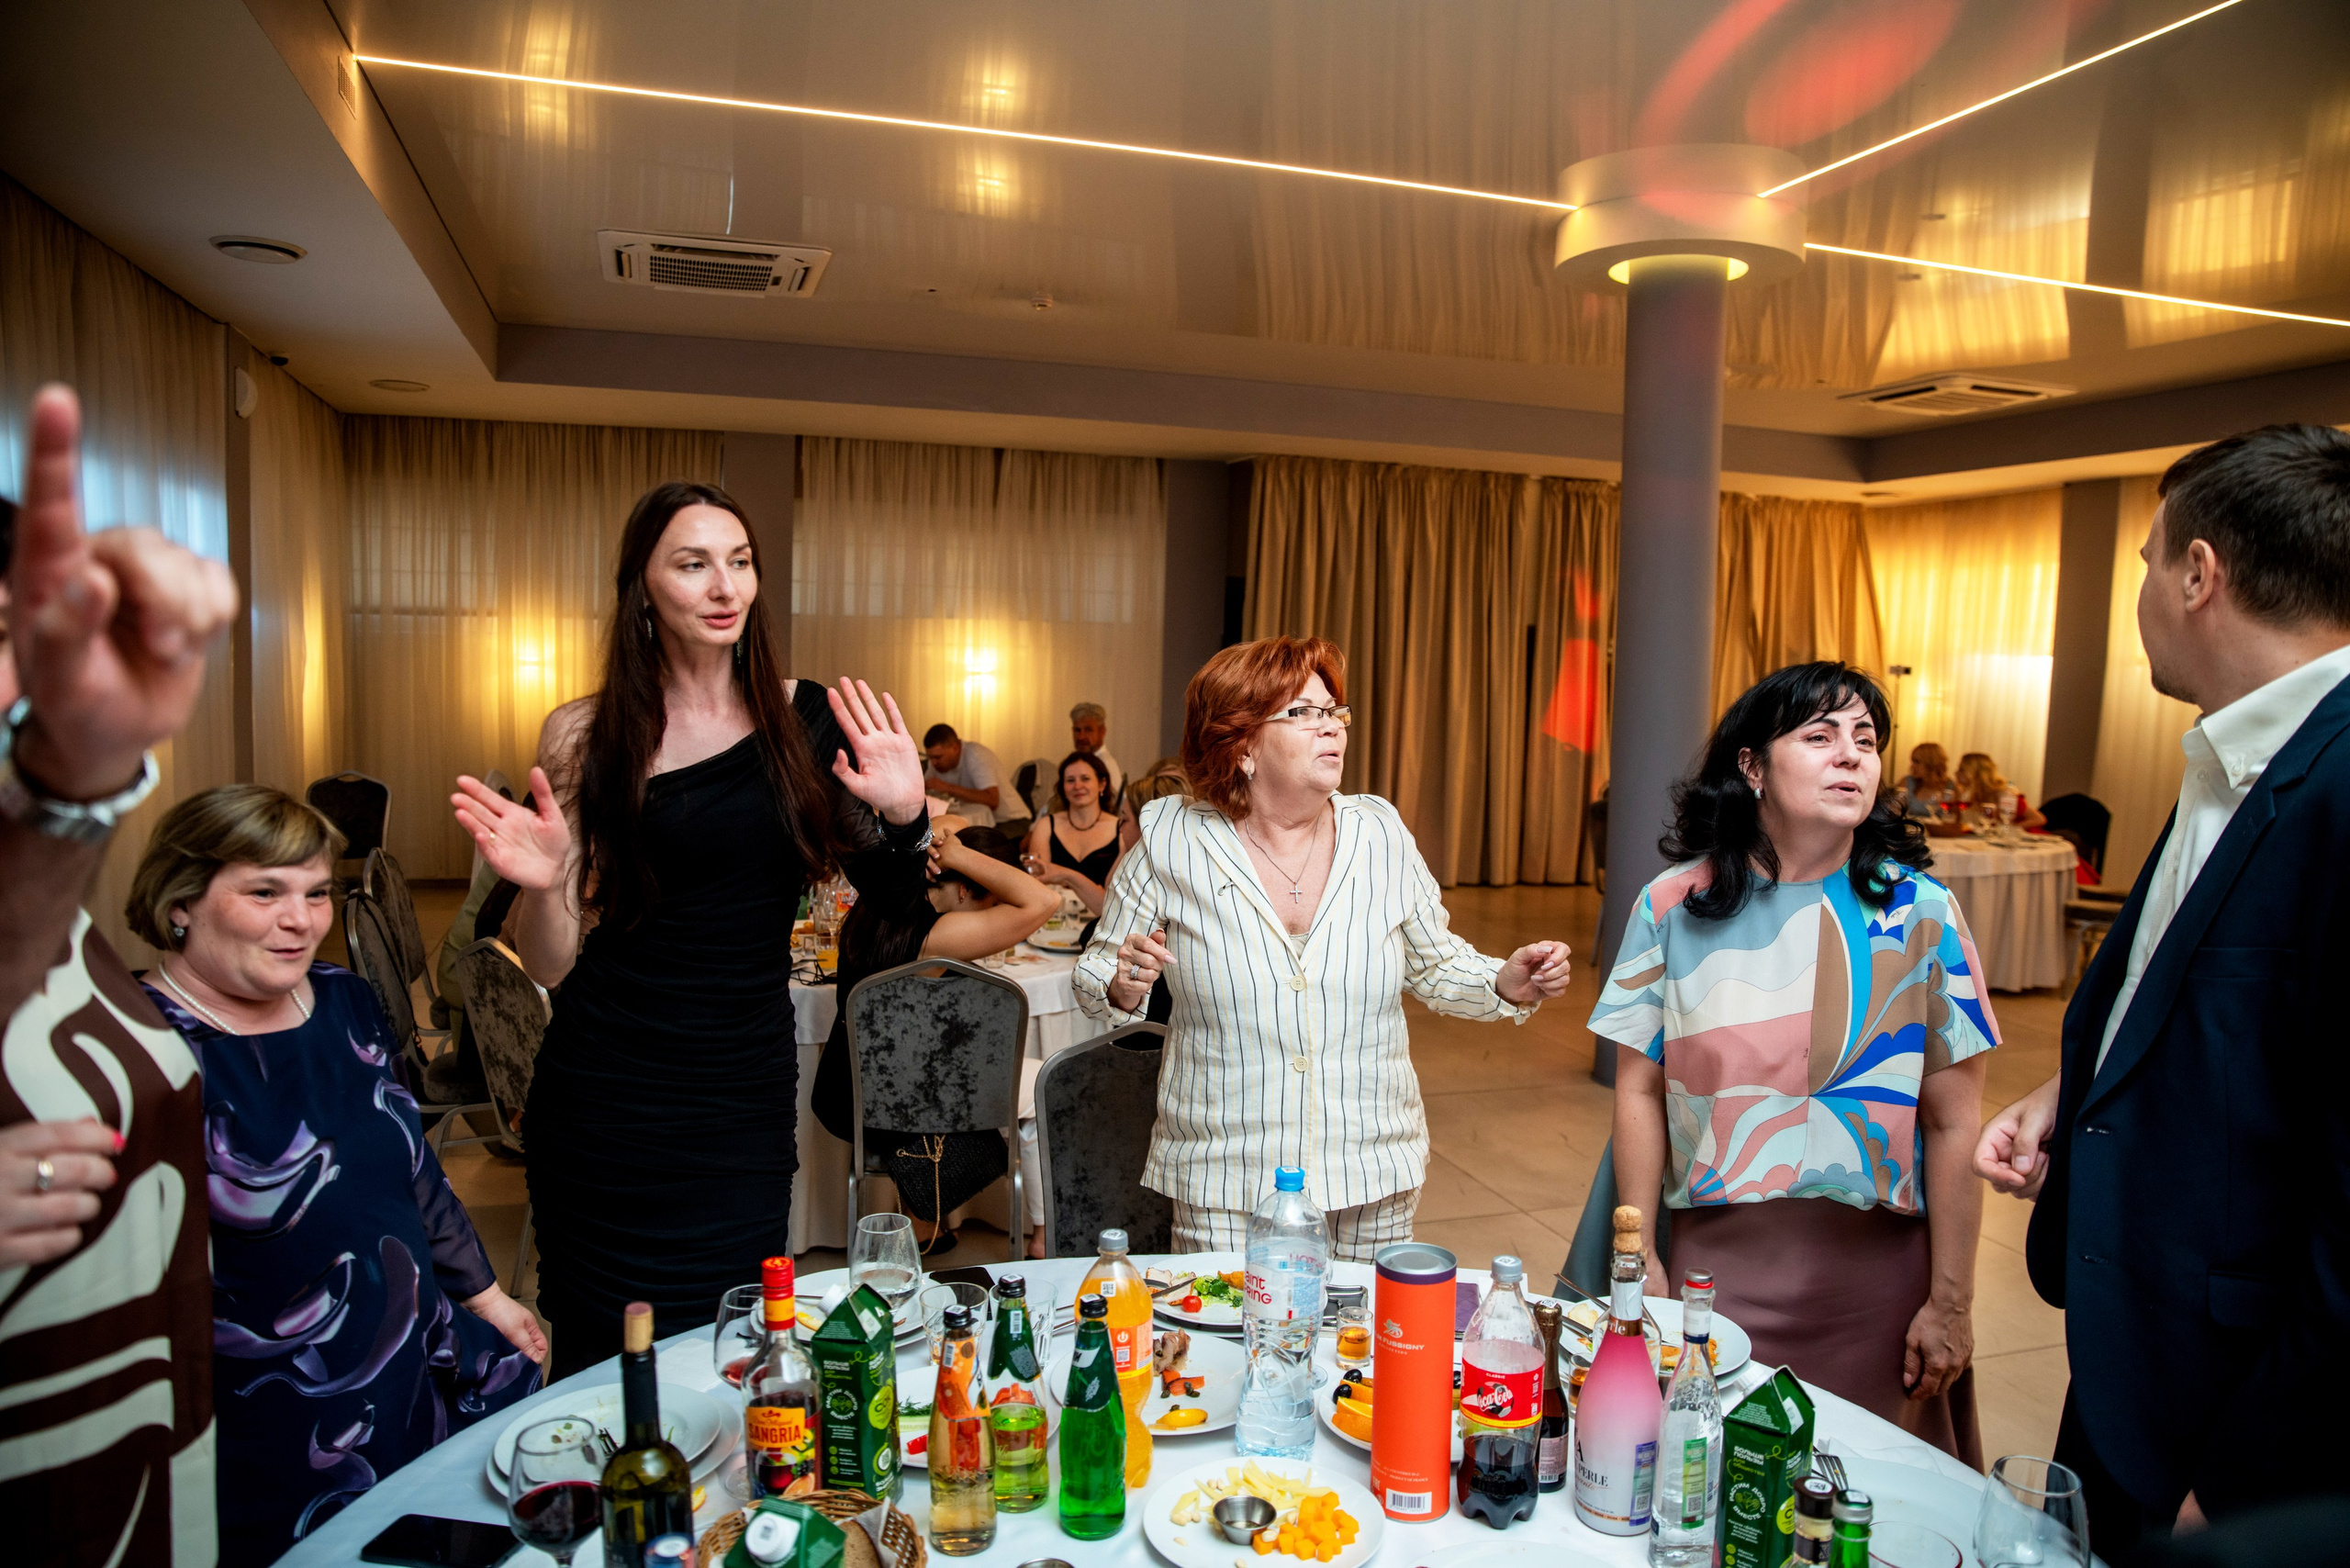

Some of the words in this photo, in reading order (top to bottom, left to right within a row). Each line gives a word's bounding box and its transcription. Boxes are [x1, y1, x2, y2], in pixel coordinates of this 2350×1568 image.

[1245, 1271, 1266, 1290] aint
[1382, 1337, 1425, 1350] FUSSIGNY
[748, 1422, 801, 1444] SANGRIA
[1733, 1450, 1764, 1466] ПОЛЬЗЫ
[1734, 1446, 1764, 1460] БОЛЬШЕ
[1578, 1463, 1608, 1487] PERLE
[1729, 1483, 1750, 1502] РАСТИМ
[1751, 1487, 1766, 1513] ДОБРО
[1732, 1505, 1762, 1520] ВМЕСТЕ
